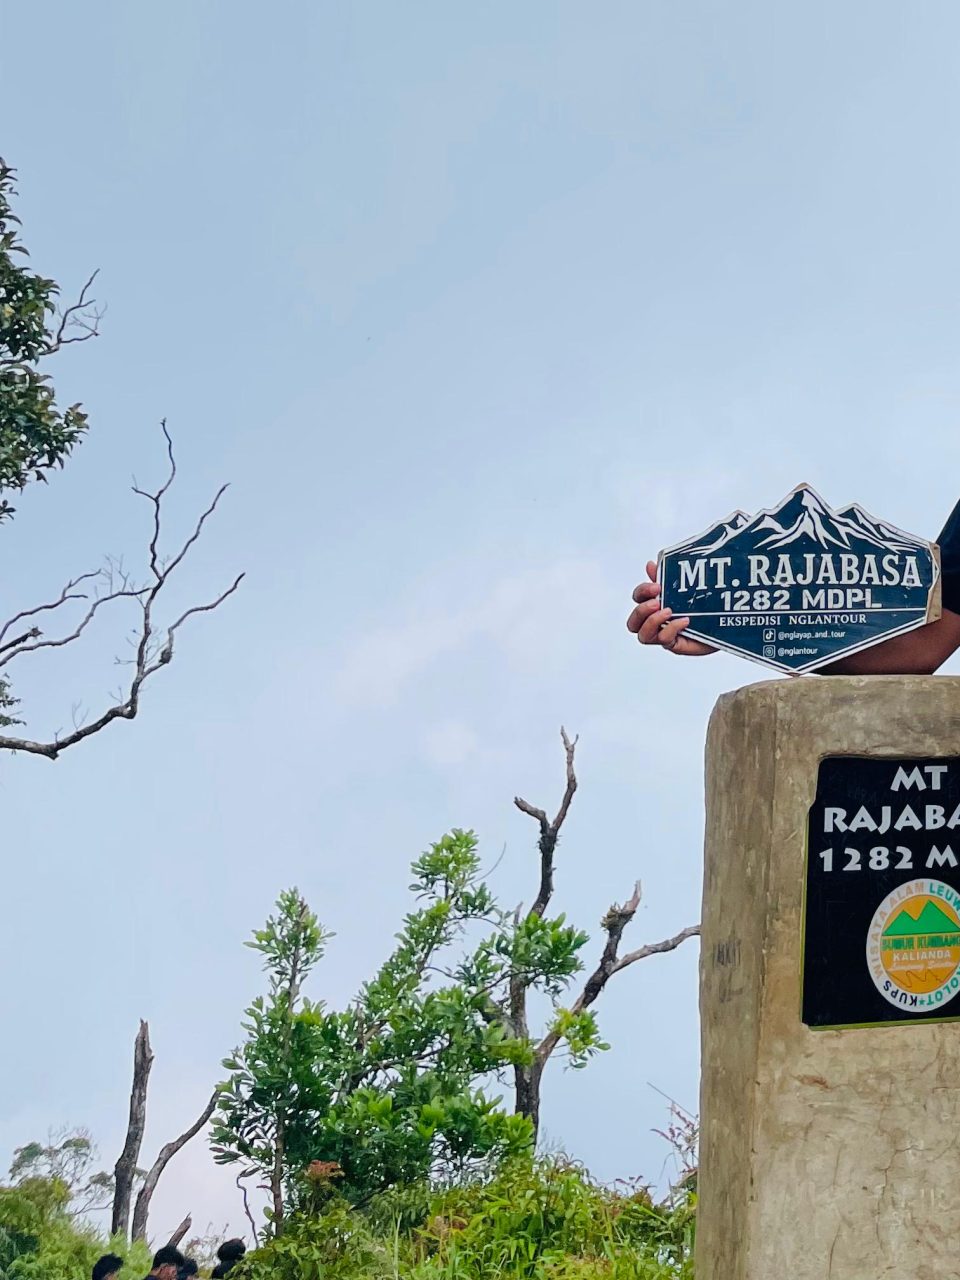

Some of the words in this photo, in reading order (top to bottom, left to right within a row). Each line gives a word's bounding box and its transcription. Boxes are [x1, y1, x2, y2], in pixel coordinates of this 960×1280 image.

[677, 557, 741, 593] MT.
[747, 553, 923, 588] RAJABASA
[720, 590, 791, 611] 1282
[802, 588, 883, 610] MDPL
[719, 615, 781, 627] EKSPEDISI
[788, 614, 867, 625] NGLANTOUR
[777, 630, 846, 641] @nglayap_and_tour
[777, 647, 819, 657] @nglantour
[890, 765, 948, 791] MT
[819, 845, 913, 872] 1282
[893, 950, 951, 961] KALIANDA
[883, 980, 918, 1007] KUPS
